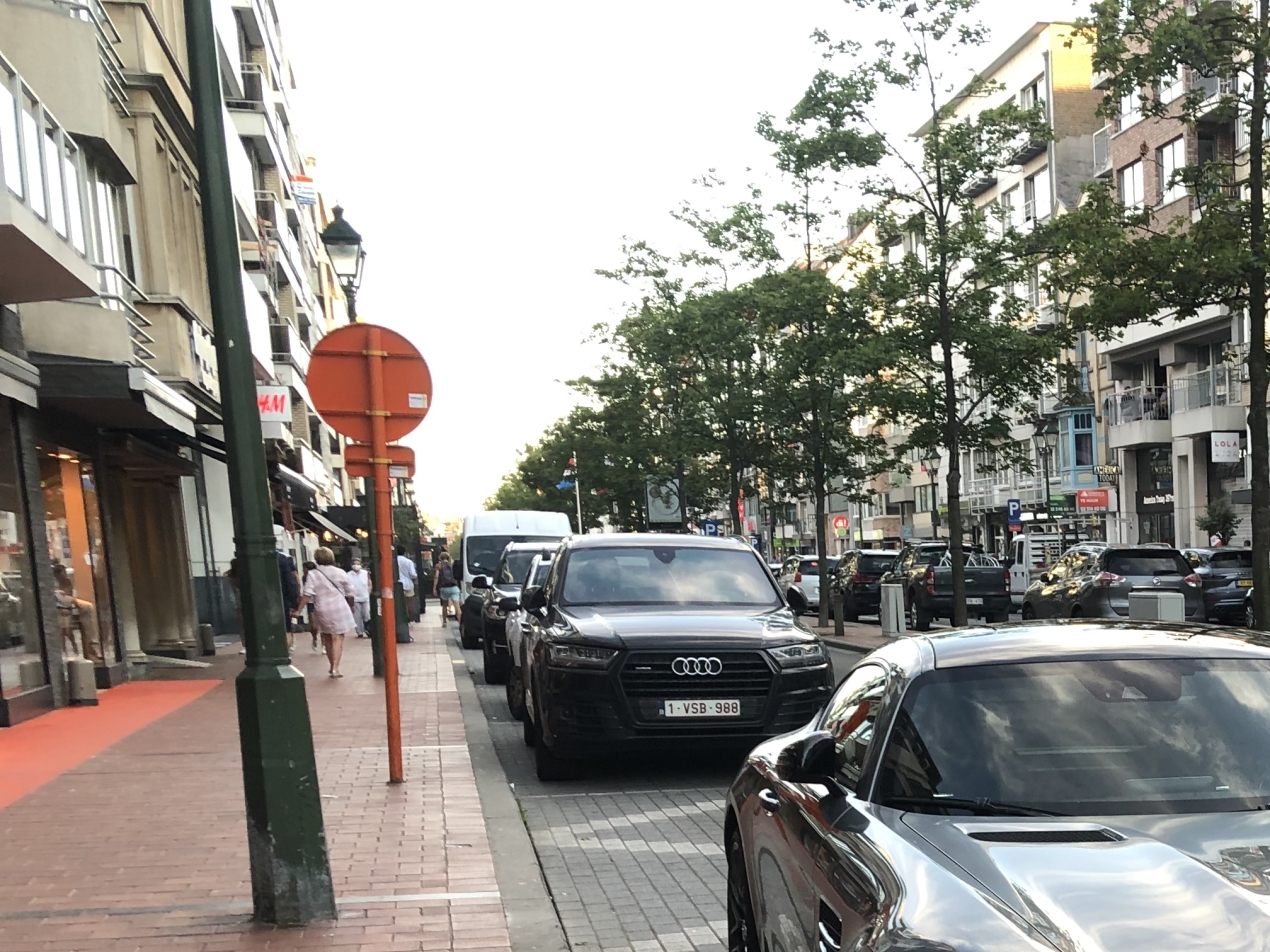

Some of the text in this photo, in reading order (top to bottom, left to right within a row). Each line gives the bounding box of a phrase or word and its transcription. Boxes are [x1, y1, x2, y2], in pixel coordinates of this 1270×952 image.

[1009, 502, 1019, 516] P
[705, 524, 716, 536] P
[751, 539, 758, 547] P
[668, 702, 739, 715] 1-VSB-988
